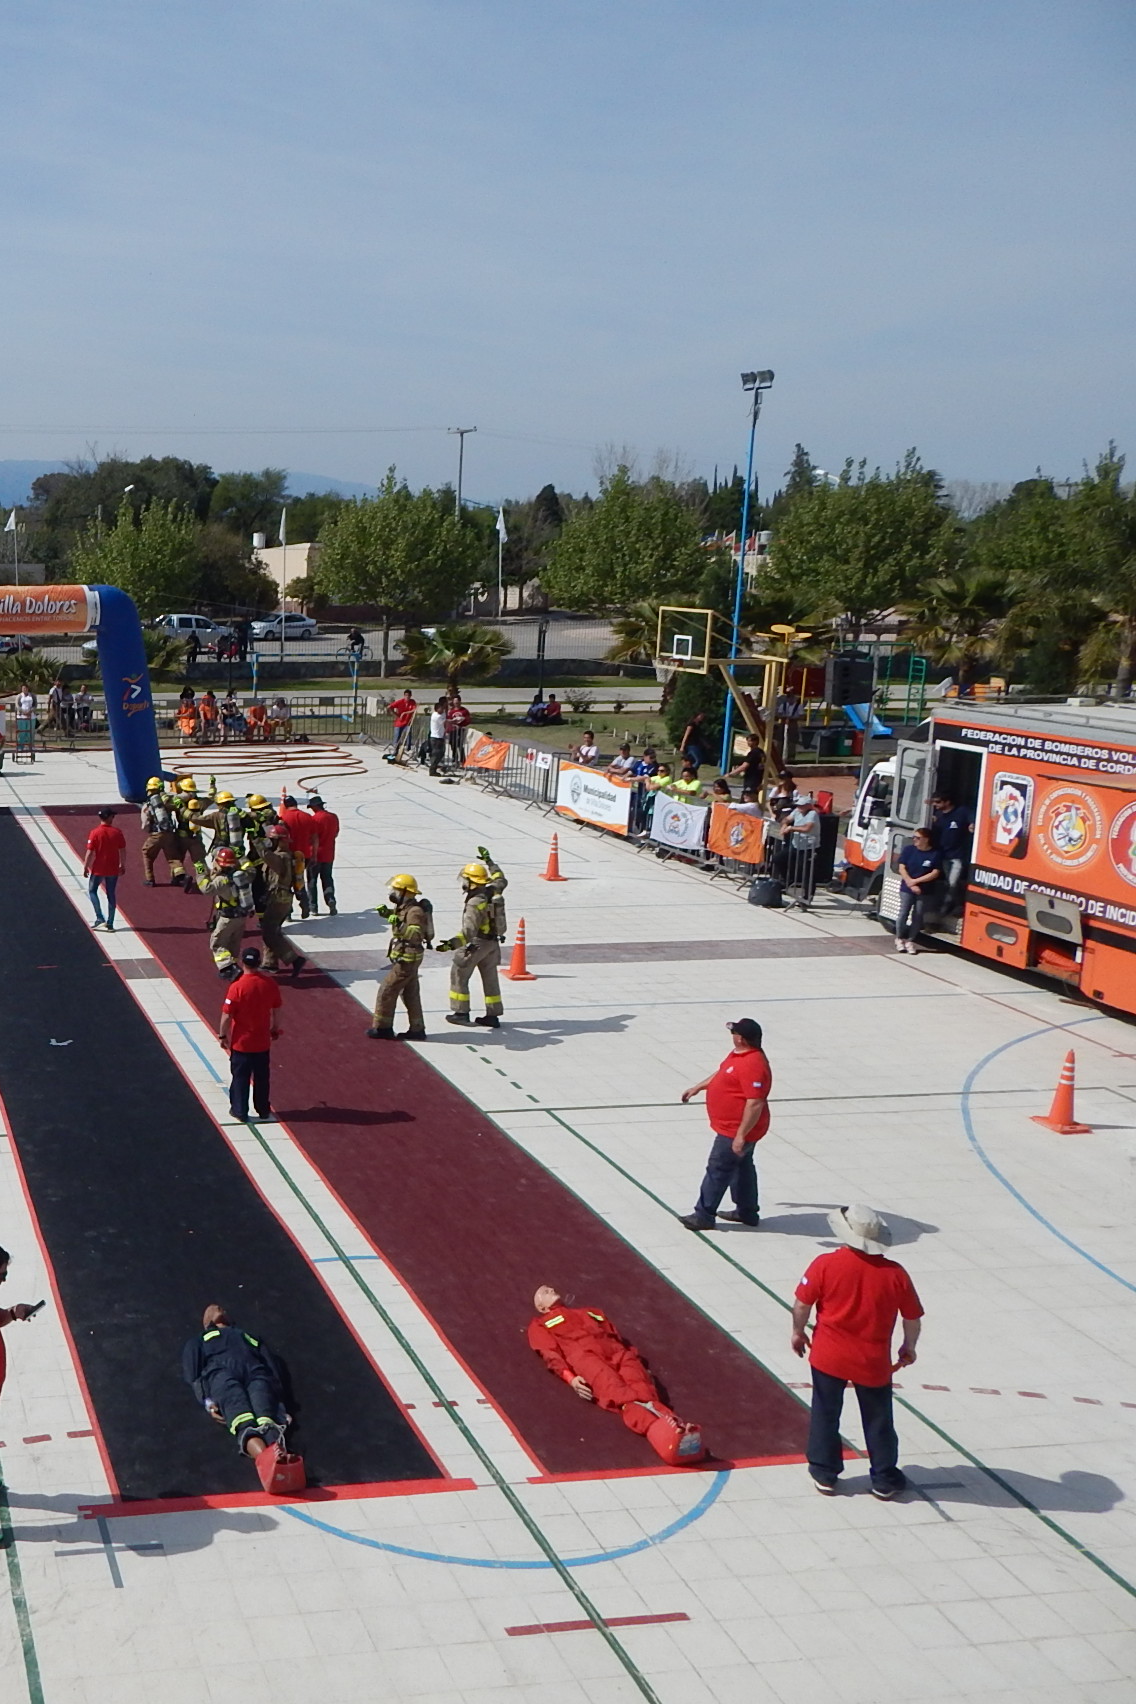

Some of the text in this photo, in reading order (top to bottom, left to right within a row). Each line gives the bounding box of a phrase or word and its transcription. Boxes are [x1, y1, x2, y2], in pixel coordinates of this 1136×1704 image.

[25, 595, 78, 614] Dolores
[961, 728, 1026, 746] FEDERACION
[1027, 738, 1043, 749] DE
[1044, 742, 1109, 760] BOMBEROS
[988, 743, 1136, 775] DE LA PROVINCIA DE CORD
[974, 868, 1013, 891] UNIDAD
[1013, 879, 1029, 895] DE
[1087, 899, 1105, 917] DE
